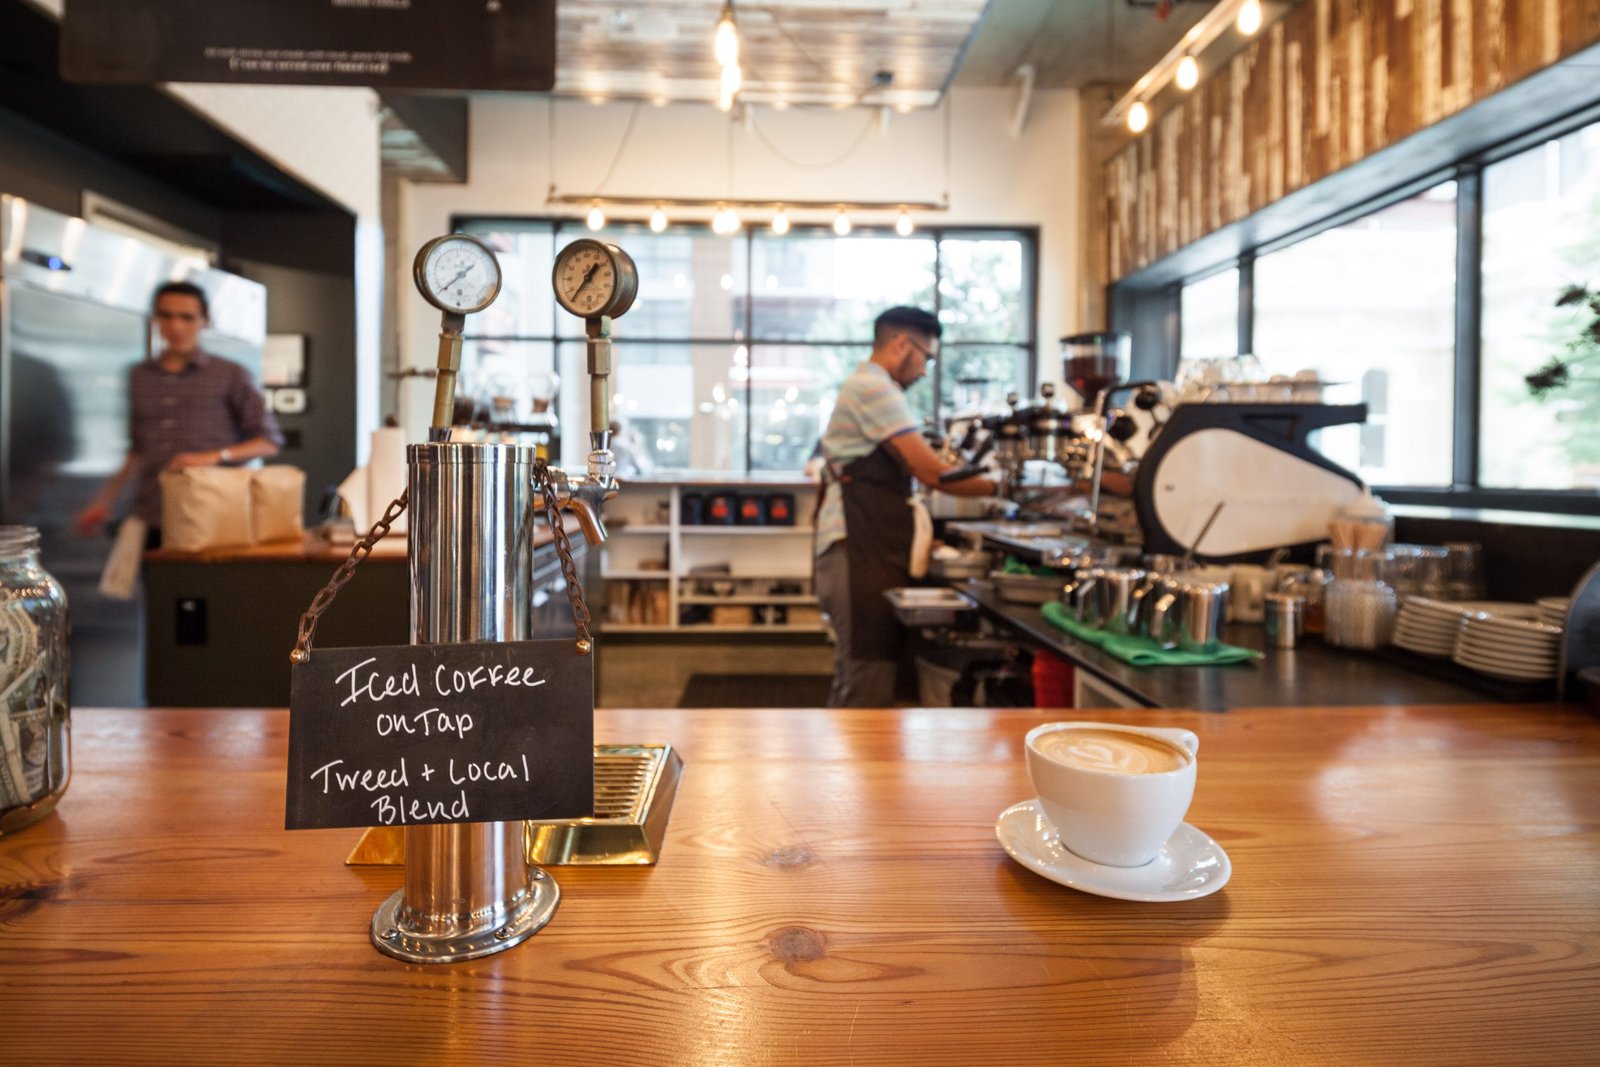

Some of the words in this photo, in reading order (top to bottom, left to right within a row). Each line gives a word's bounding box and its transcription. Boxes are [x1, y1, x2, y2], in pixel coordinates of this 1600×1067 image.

[335, 657, 420, 706] Iced
[311, 758, 408, 793] Tweed
[422, 764, 435, 781] +
[450, 754, 529, 785] Local
[370, 789, 469, 825] Blend
